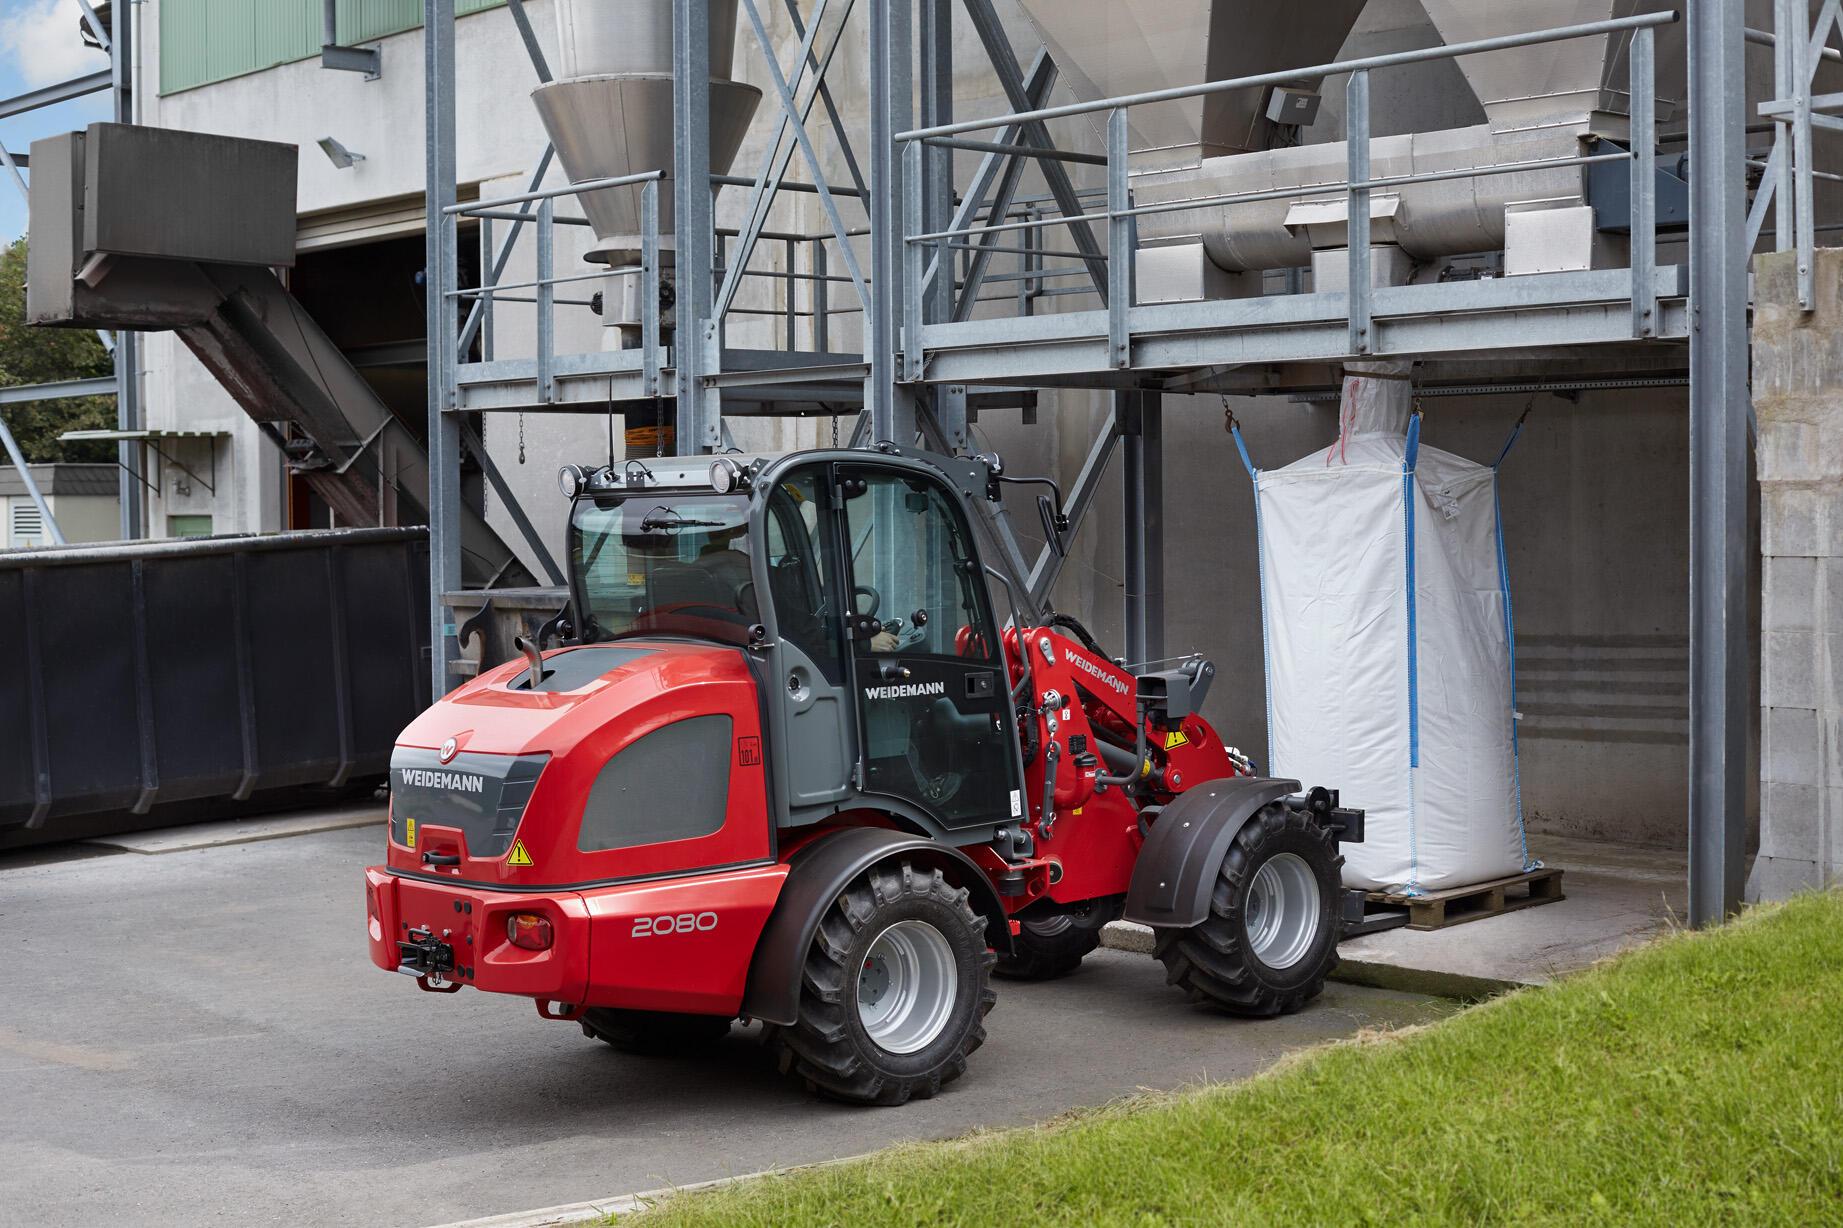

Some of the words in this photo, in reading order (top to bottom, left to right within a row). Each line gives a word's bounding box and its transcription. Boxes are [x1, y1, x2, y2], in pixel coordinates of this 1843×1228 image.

[1065, 648, 1129, 695] WEIDEMANN
[865, 681, 944, 700] WEIDEMANN
[741, 749, 753, 764] 101
[402, 768, 484, 793] WEIDEMANN
[631, 911, 718, 938] 2080
